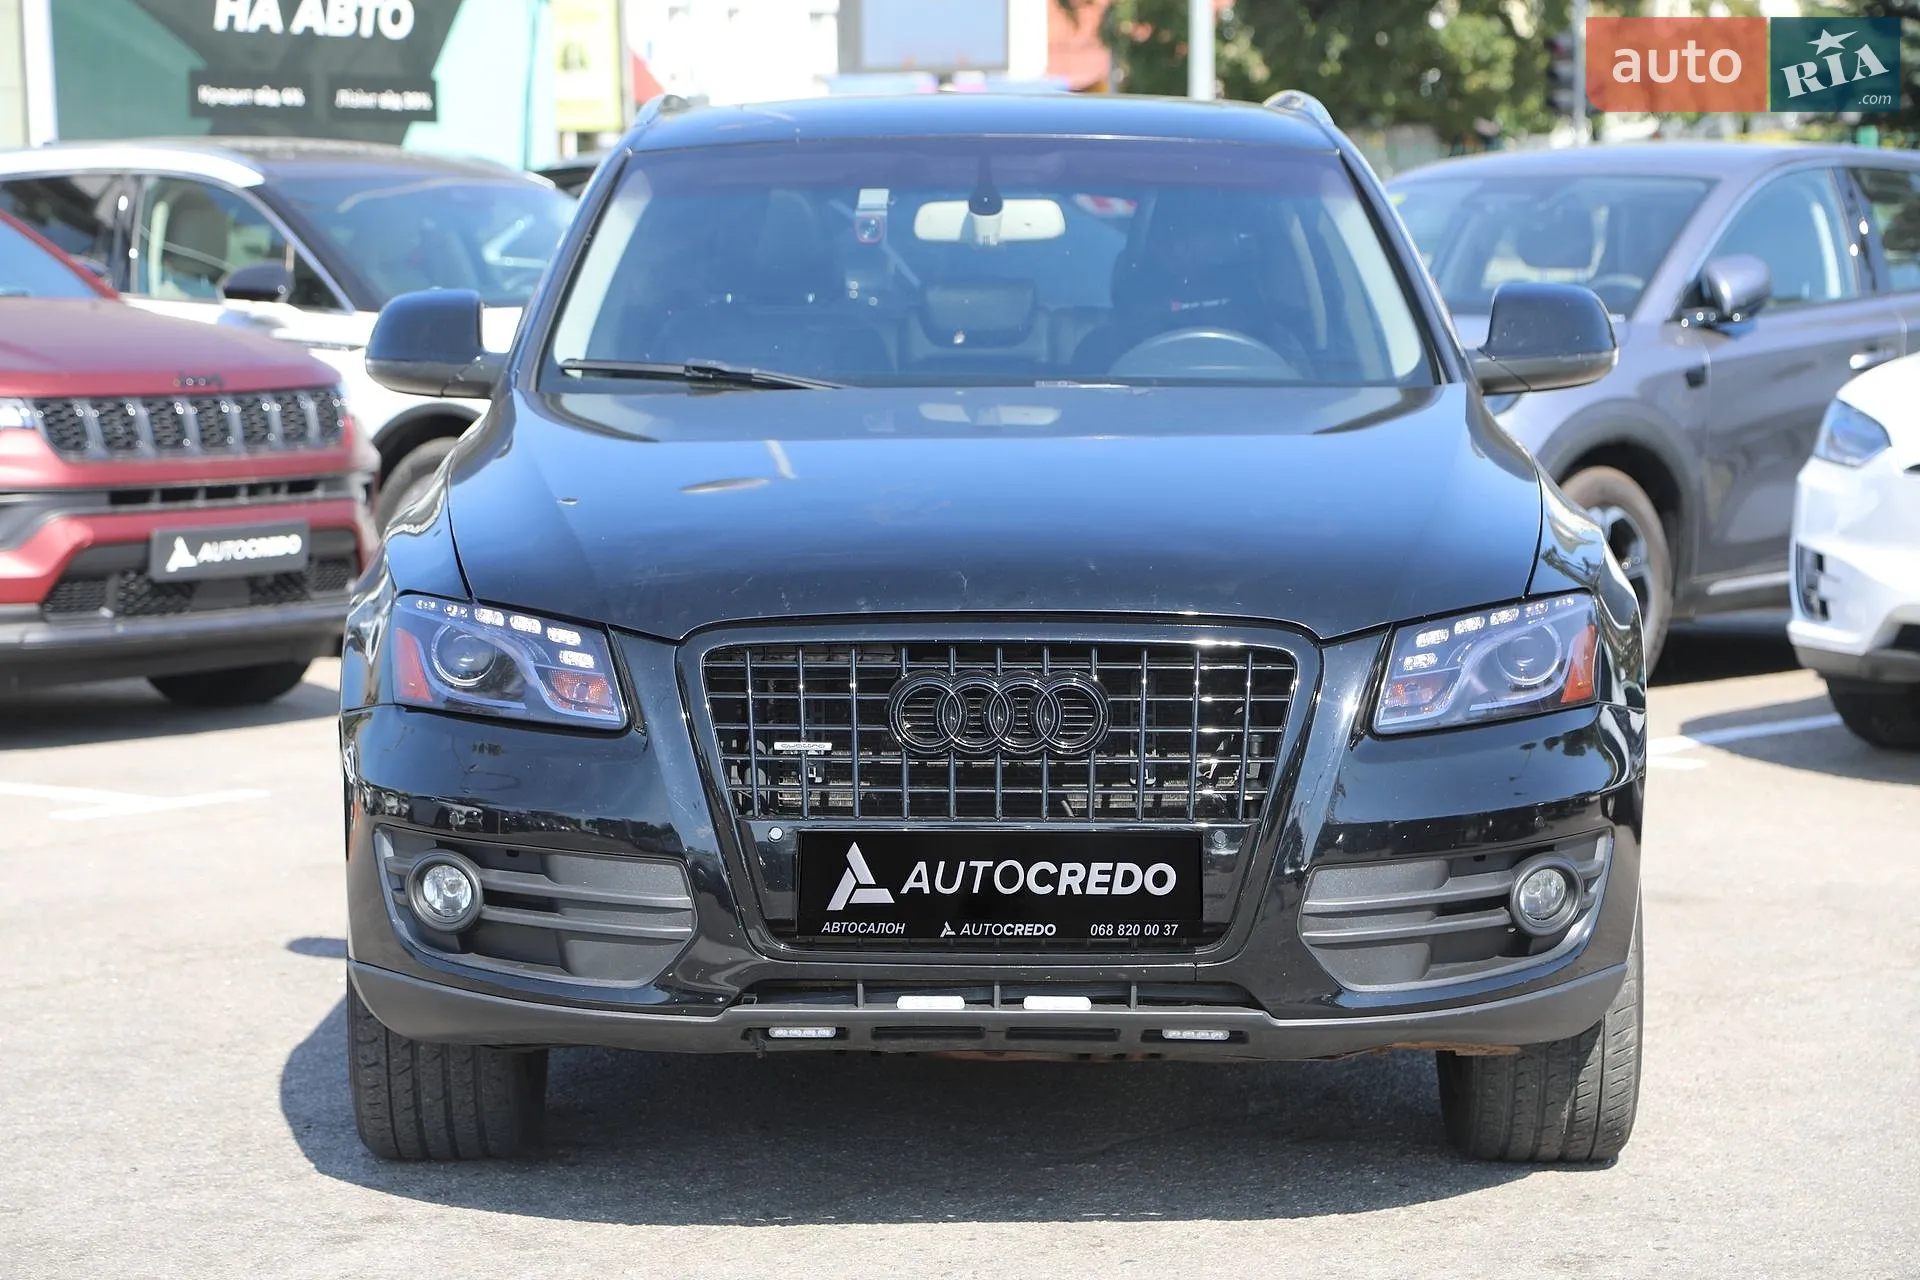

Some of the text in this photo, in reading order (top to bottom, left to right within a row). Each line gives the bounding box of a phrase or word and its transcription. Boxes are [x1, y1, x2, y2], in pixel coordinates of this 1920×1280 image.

[213, 0, 414, 40] НА АВТО
[900, 859, 1177, 896] AUTOCREDO
[821, 921, 906, 934] АВТОСАЛОН
[960, 923, 1057, 936] AUTOCREDO
[1090, 923, 1179, 936] 068 820 00 37
